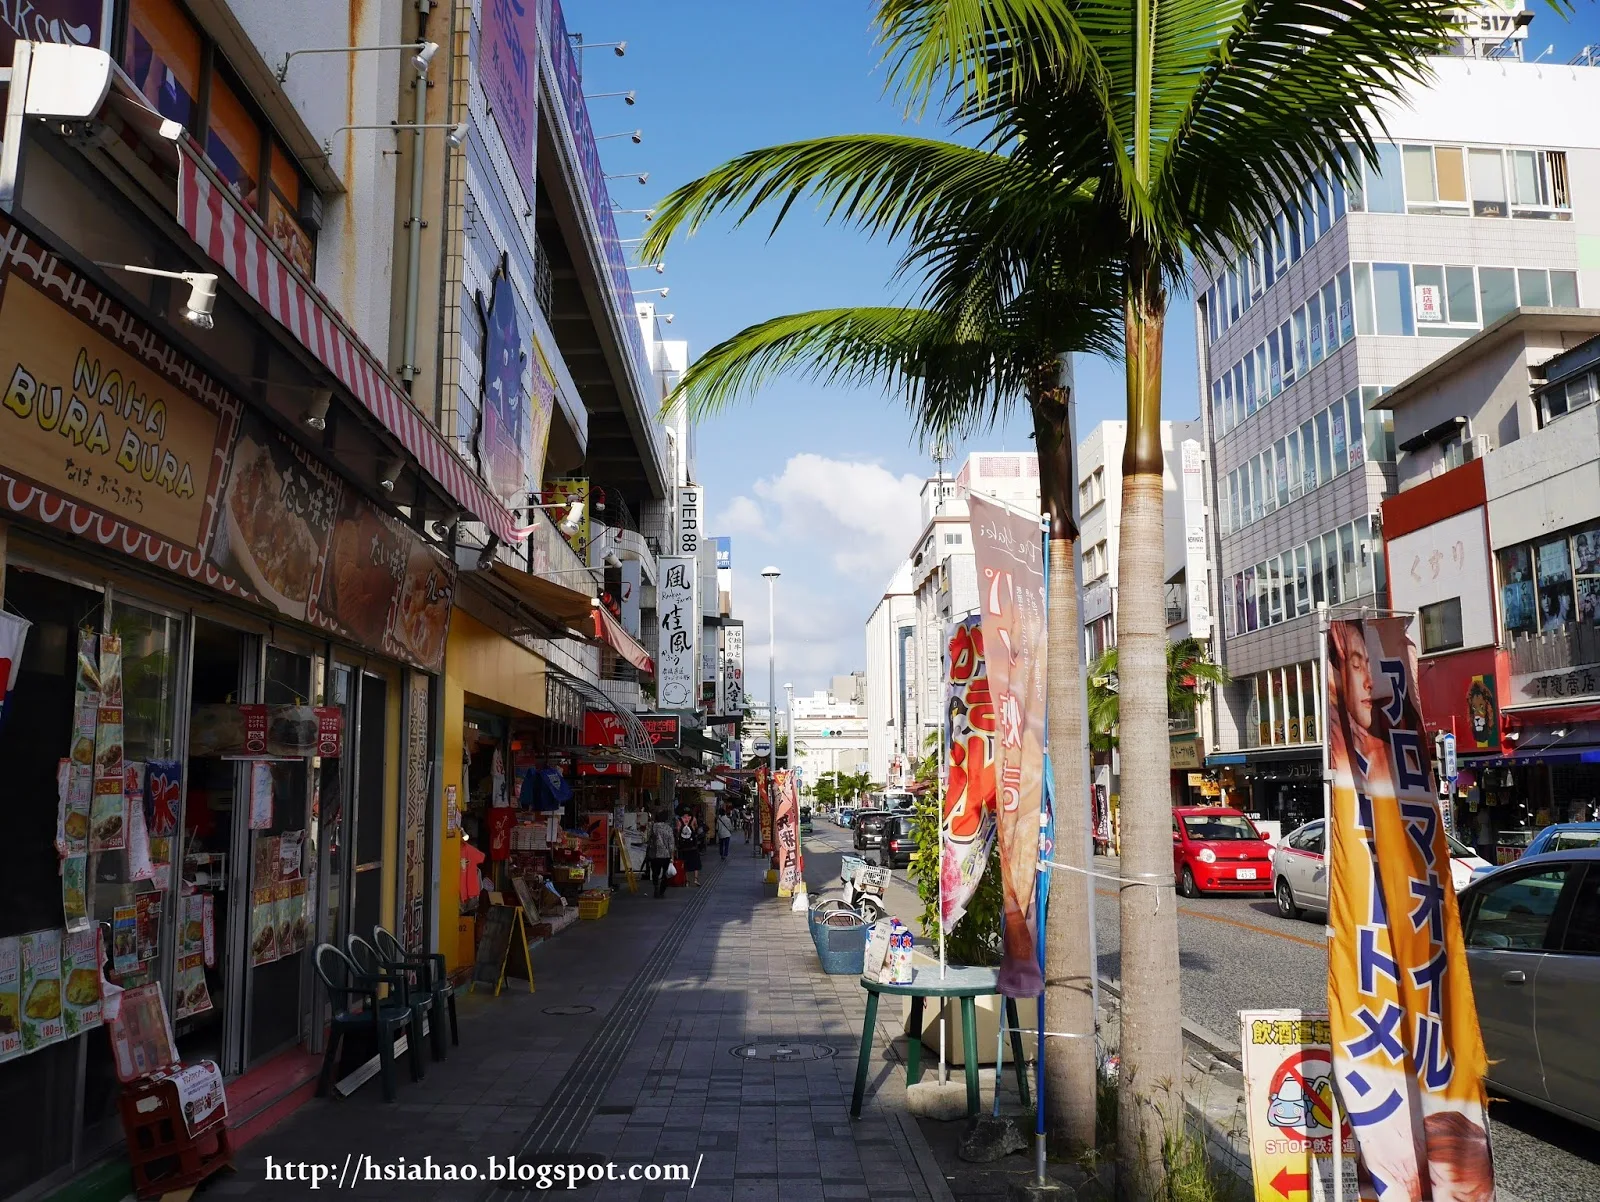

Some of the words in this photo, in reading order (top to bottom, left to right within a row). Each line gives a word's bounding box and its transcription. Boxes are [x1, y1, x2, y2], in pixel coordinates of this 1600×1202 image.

[73, 347, 167, 441] NAHA
[3, 363, 110, 455] BURA
[115, 427, 195, 499] BURA
[280, 466, 335, 531] たこ焼き
[682, 492, 697, 530] PIER
[682, 533, 697, 552] 88
[1410, 541, 1465, 580] くすり
[407, 688, 419, 830] OKINAWA
[150, 772, 180, 835] 氷
[1379, 656, 1455, 1092] アロマオイル
[42, 1023, 63, 1037] 180円
[1252, 1019, 1331, 1046] 飲酒運転
